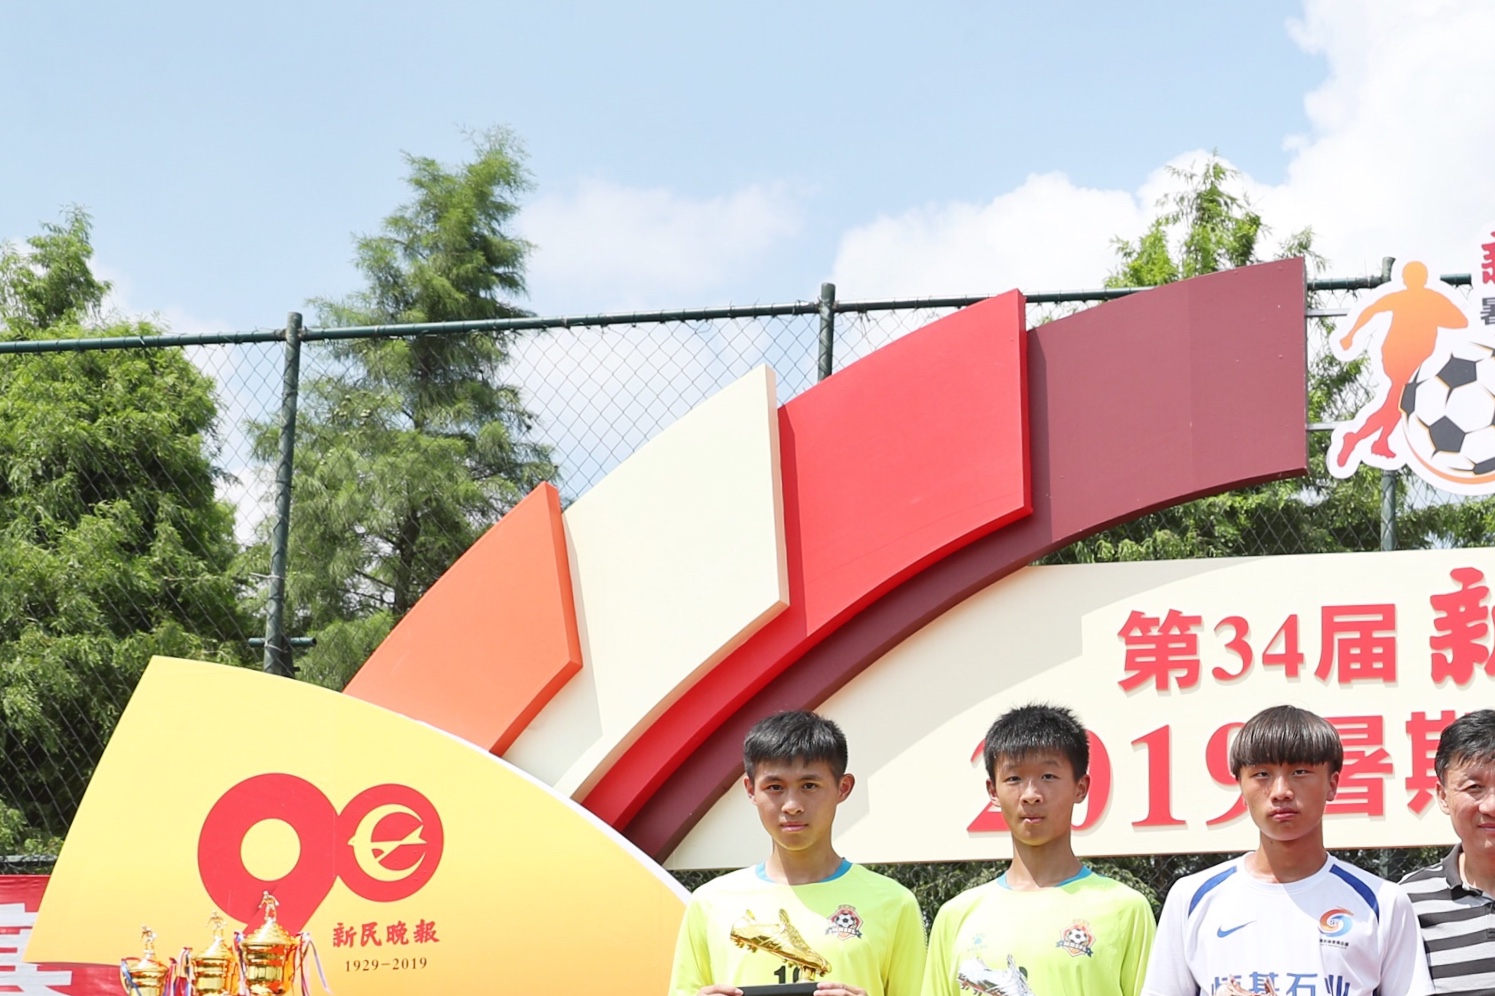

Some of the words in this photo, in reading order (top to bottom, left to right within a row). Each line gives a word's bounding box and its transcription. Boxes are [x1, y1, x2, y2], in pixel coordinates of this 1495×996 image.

[332, 919, 440, 948] 新民晚報
[345, 957, 428, 972] 1929-2019
